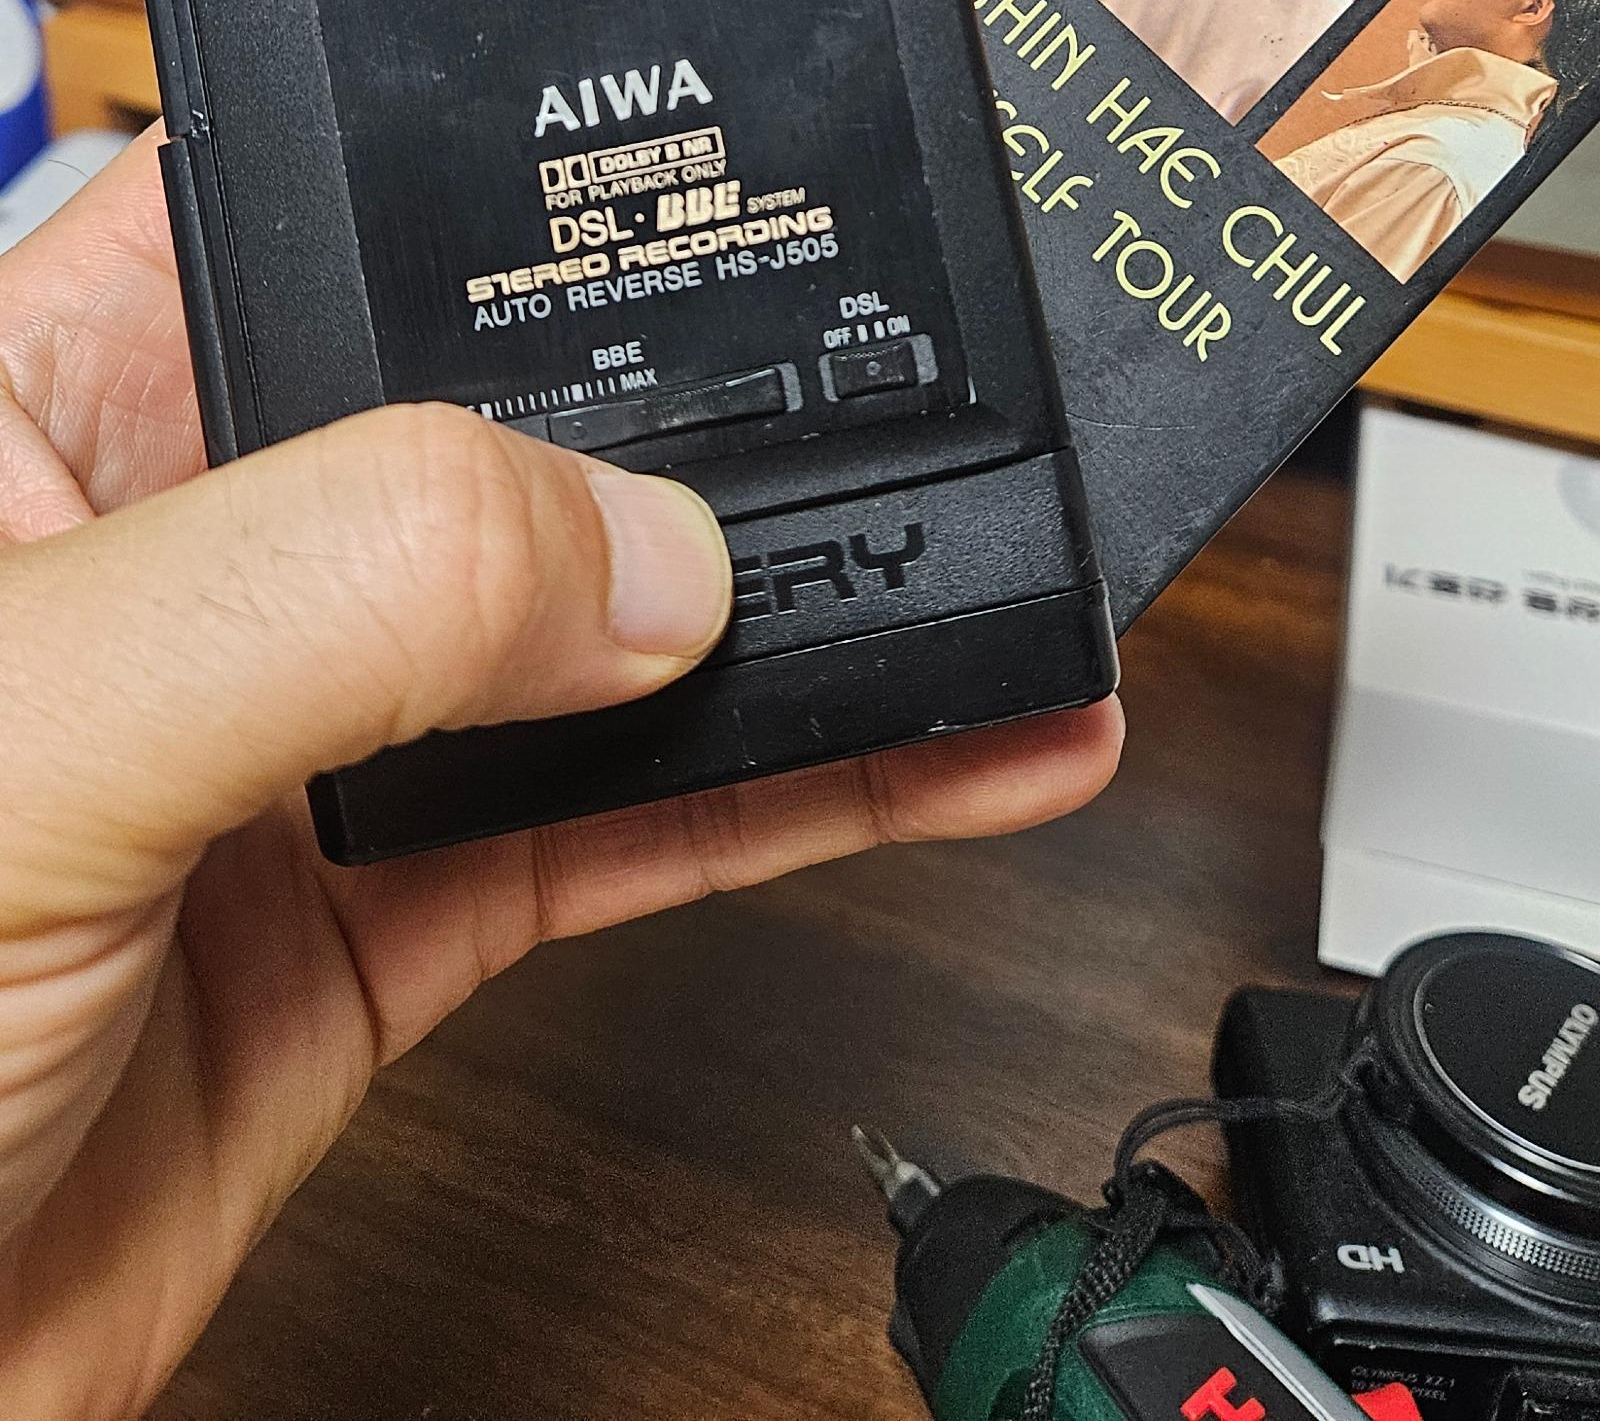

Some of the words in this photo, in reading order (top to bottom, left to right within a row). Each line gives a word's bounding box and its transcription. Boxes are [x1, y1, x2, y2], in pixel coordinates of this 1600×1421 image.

[534, 58, 714, 138] AIWA
[545, 189, 584, 211] FOR
[588, 169, 680, 202] PLAYBACK
[681, 158, 727, 184] ONLY
[600, 146, 662, 174] DOLBY
[664, 143, 681, 161] B
[682, 135, 714, 157] NR
[549, 206, 634, 254] DSL
[746, 187, 806, 215] SYSTEM
[1086, 77, 1222, 209] HAE
[1222, 205, 1366, 356] CHUL
[466, 252, 610, 304] STEREO
[618, 206, 833, 272] RECORDING
[474, 293, 552, 331] AUTO
[566, 261, 702, 313] REVERSE
[716, 232, 839, 280] HS-J505
[839, 290, 890, 319] DSL
[1092, 210, 1233, 363] TOUR
[592, 341, 645, 371] BBE
[823, 326, 852, 349] OFF
[886, 315, 911, 336] ON
[619, 367, 658, 393] MAX
[1518, 1003, 1598, 1111] OLYMPUS
[1337, 1244, 1405, 1274] HD
